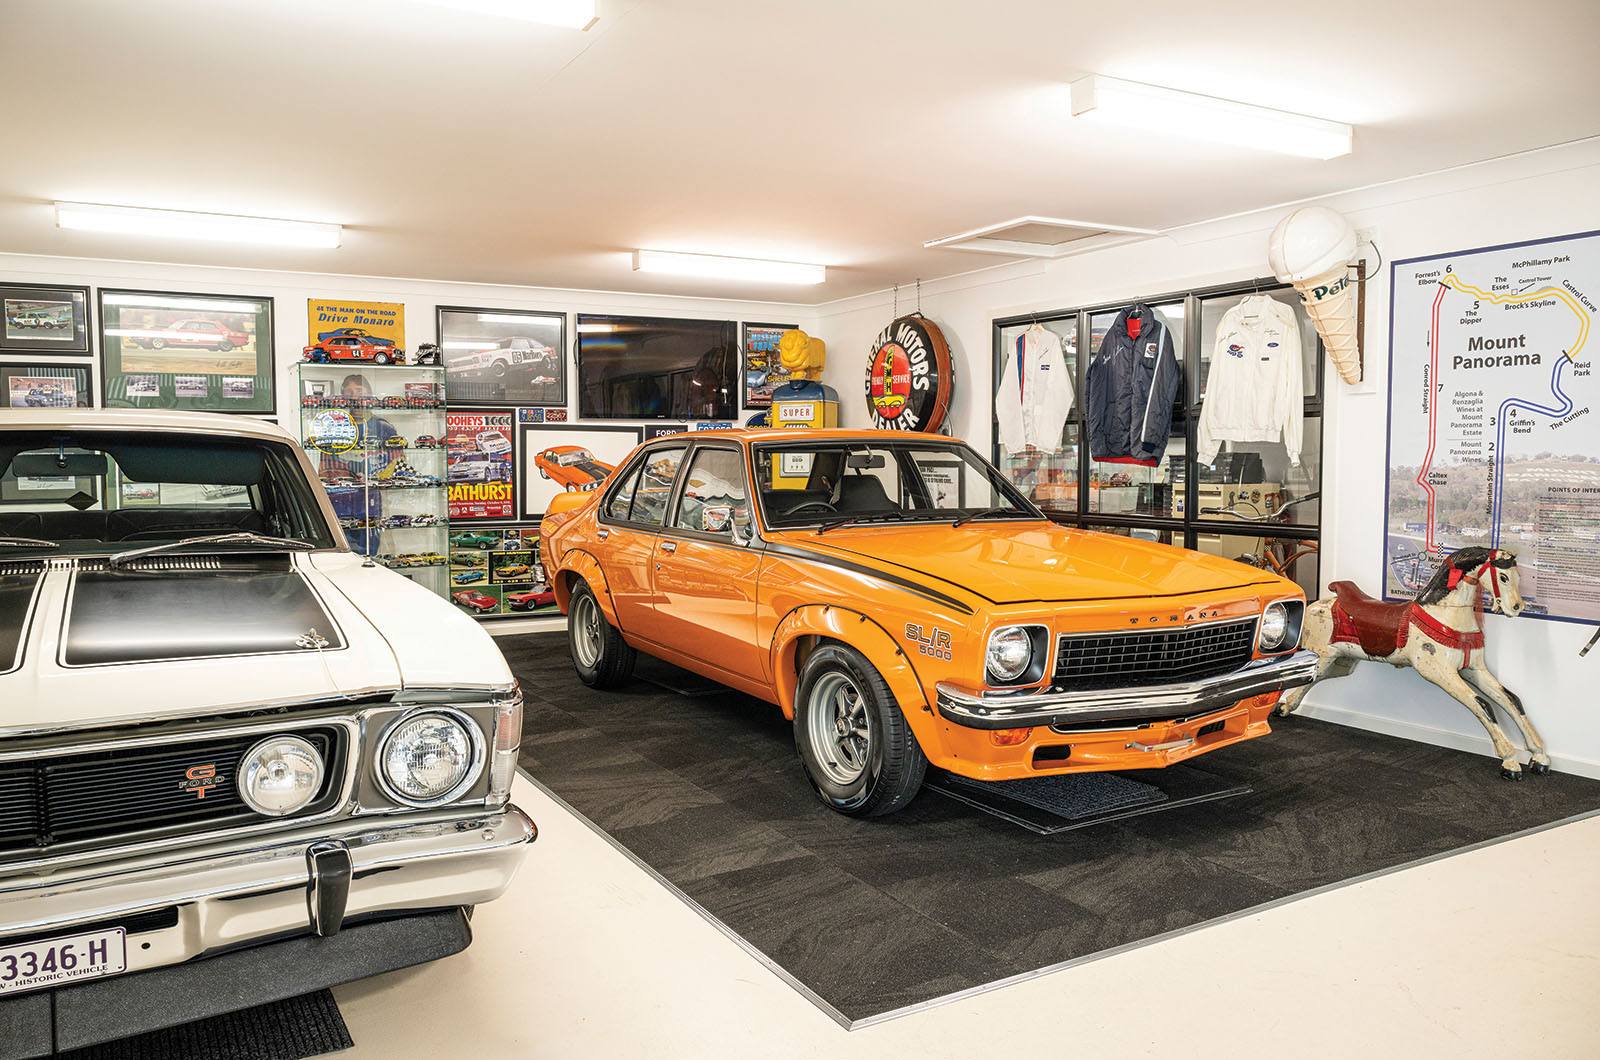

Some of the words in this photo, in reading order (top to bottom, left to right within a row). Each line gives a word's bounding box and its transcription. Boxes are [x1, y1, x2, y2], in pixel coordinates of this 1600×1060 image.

[1512, 256, 1552, 269] McPhillamy
[1553, 255, 1570, 265] Park
[1415, 270, 1441, 279] Forrest's
[1445, 264, 1452, 274] 6
[1491, 283, 1510, 291] Esses
[1562, 279, 1582, 299] Castrol
[1580, 296, 1597, 313] Curve
[1474, 300, 1480, 309] 5
[1504, 301, 1529, 311] Brock's
[1530, 299, 1556, 309] Skyline
[318, 313, 348, 323] Drive
[353, 316, 394, 326] Monaro
[1460, 316, 1482, 326] Dipper
[1468, 334, 1526, 351] Mount
[896, 323, 929, 390] MOTORS
[1453, 352, 1541, 370] Panorama
[1438, 384, 1444, 392] 7
[784, 408, 810, 416] SUPER
[1510, 409, 1517, 418] 4
[1490, 417, 1496, 426] 3
[1550, 419, 1563, 431] The
[1563, 406, 1590, 423] Cutting
[1488, 442, 1495, 451] 2
[448, 485, 512, 501] BATHURST
[1130, 611, 1218, 624] TORANA
[906, 623, 952, 649] SL/R
[919, 644, 952, 661] 5000
[178, 776, 225, 788] FORD
[15, 972, 64, 986] HISTORIC
[66, 965, 108, 978] VEHICLE
